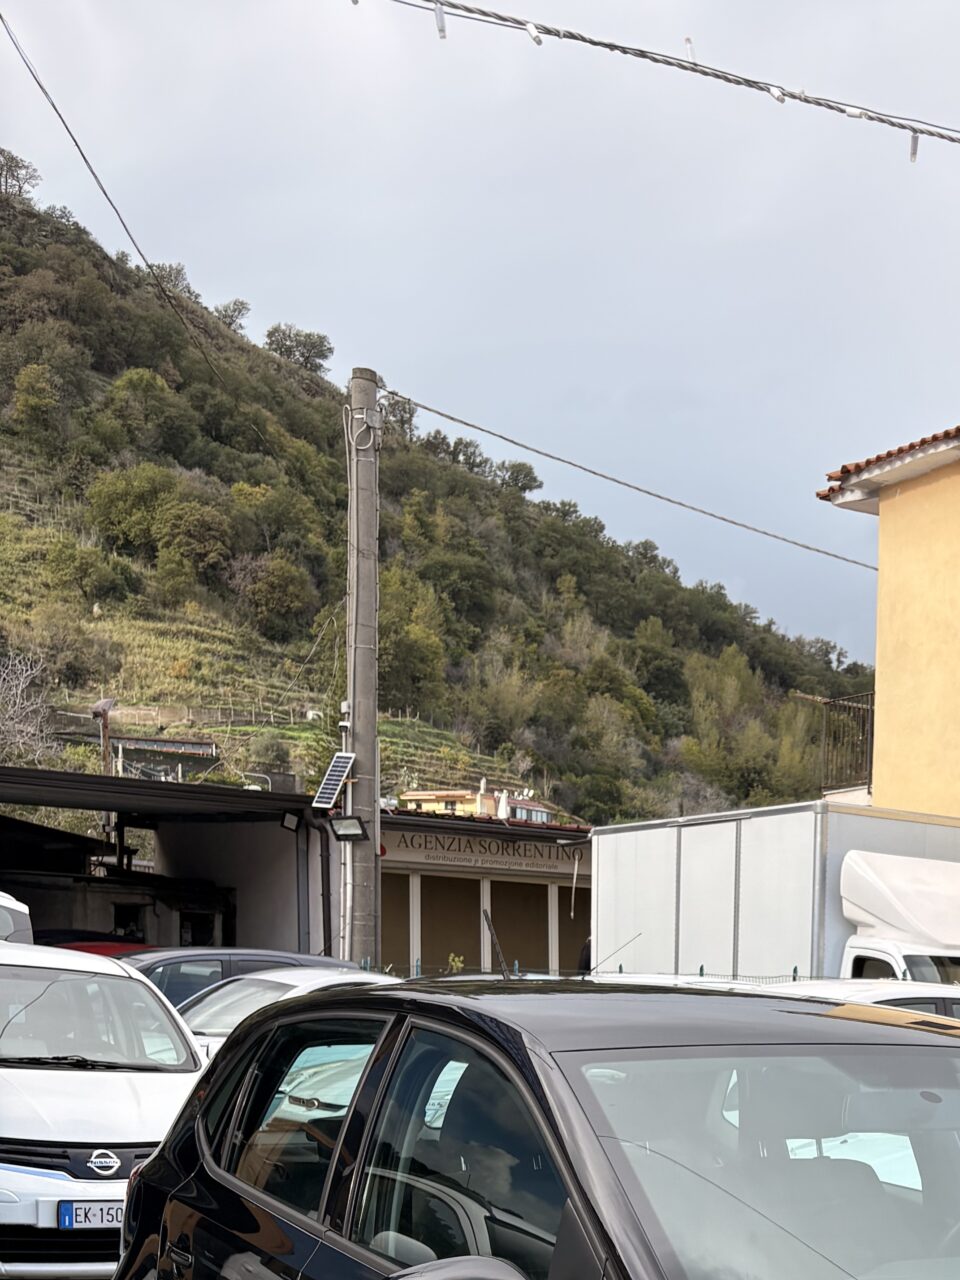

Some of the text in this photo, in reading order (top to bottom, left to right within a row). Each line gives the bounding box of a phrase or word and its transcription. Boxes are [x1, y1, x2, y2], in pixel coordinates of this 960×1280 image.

[397, 833, 584, 863] AGENZIA SORRENTINO
[424, 853, 473, 864] distribuzione
[525, 861, 559, 870] editoriale
[74, 1207, 92, 1224] EK
[99, 1207, 124, 1224] 150
